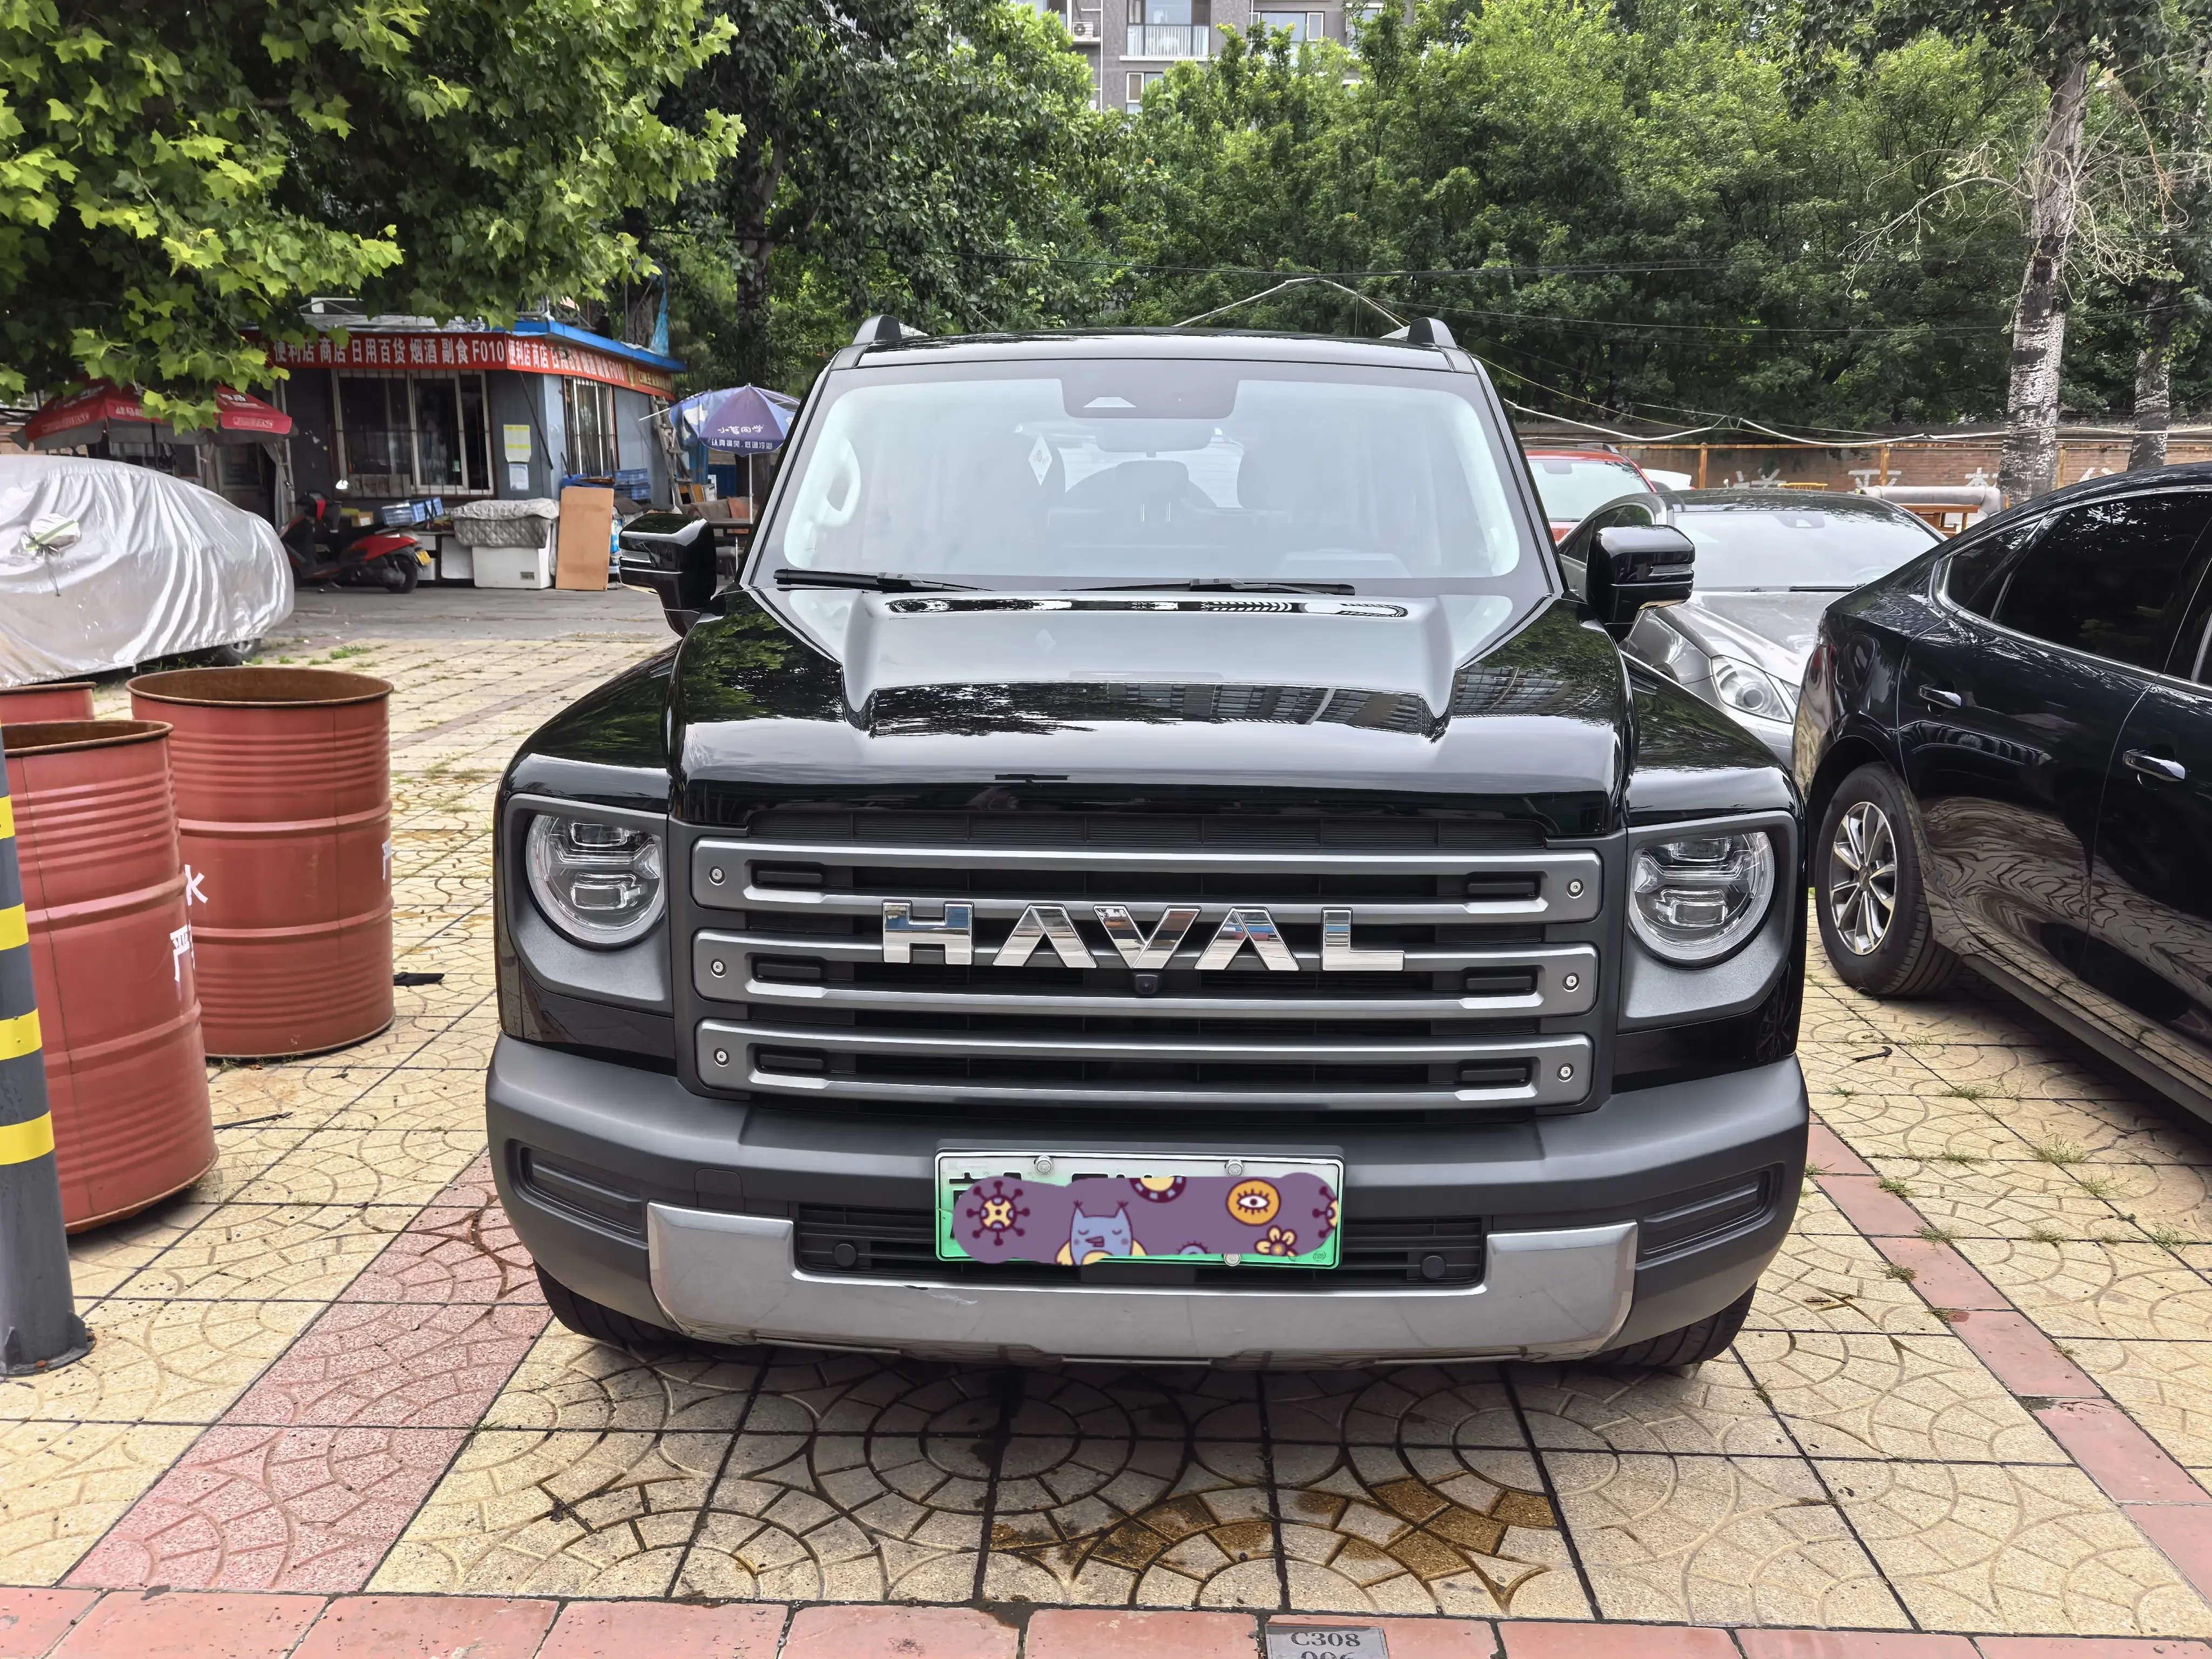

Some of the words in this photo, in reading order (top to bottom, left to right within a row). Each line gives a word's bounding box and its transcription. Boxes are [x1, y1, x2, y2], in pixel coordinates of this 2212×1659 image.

[352, 337, 406, 364] 日用百货
[410, 338, 438, 364] 烟酒
[442, 338, 469, 365] 副食
[473, 339, 504, 362] F010
[882, 900, 1405, 970] HAVAL
[1291, 1631, 1361, 1647] C308
